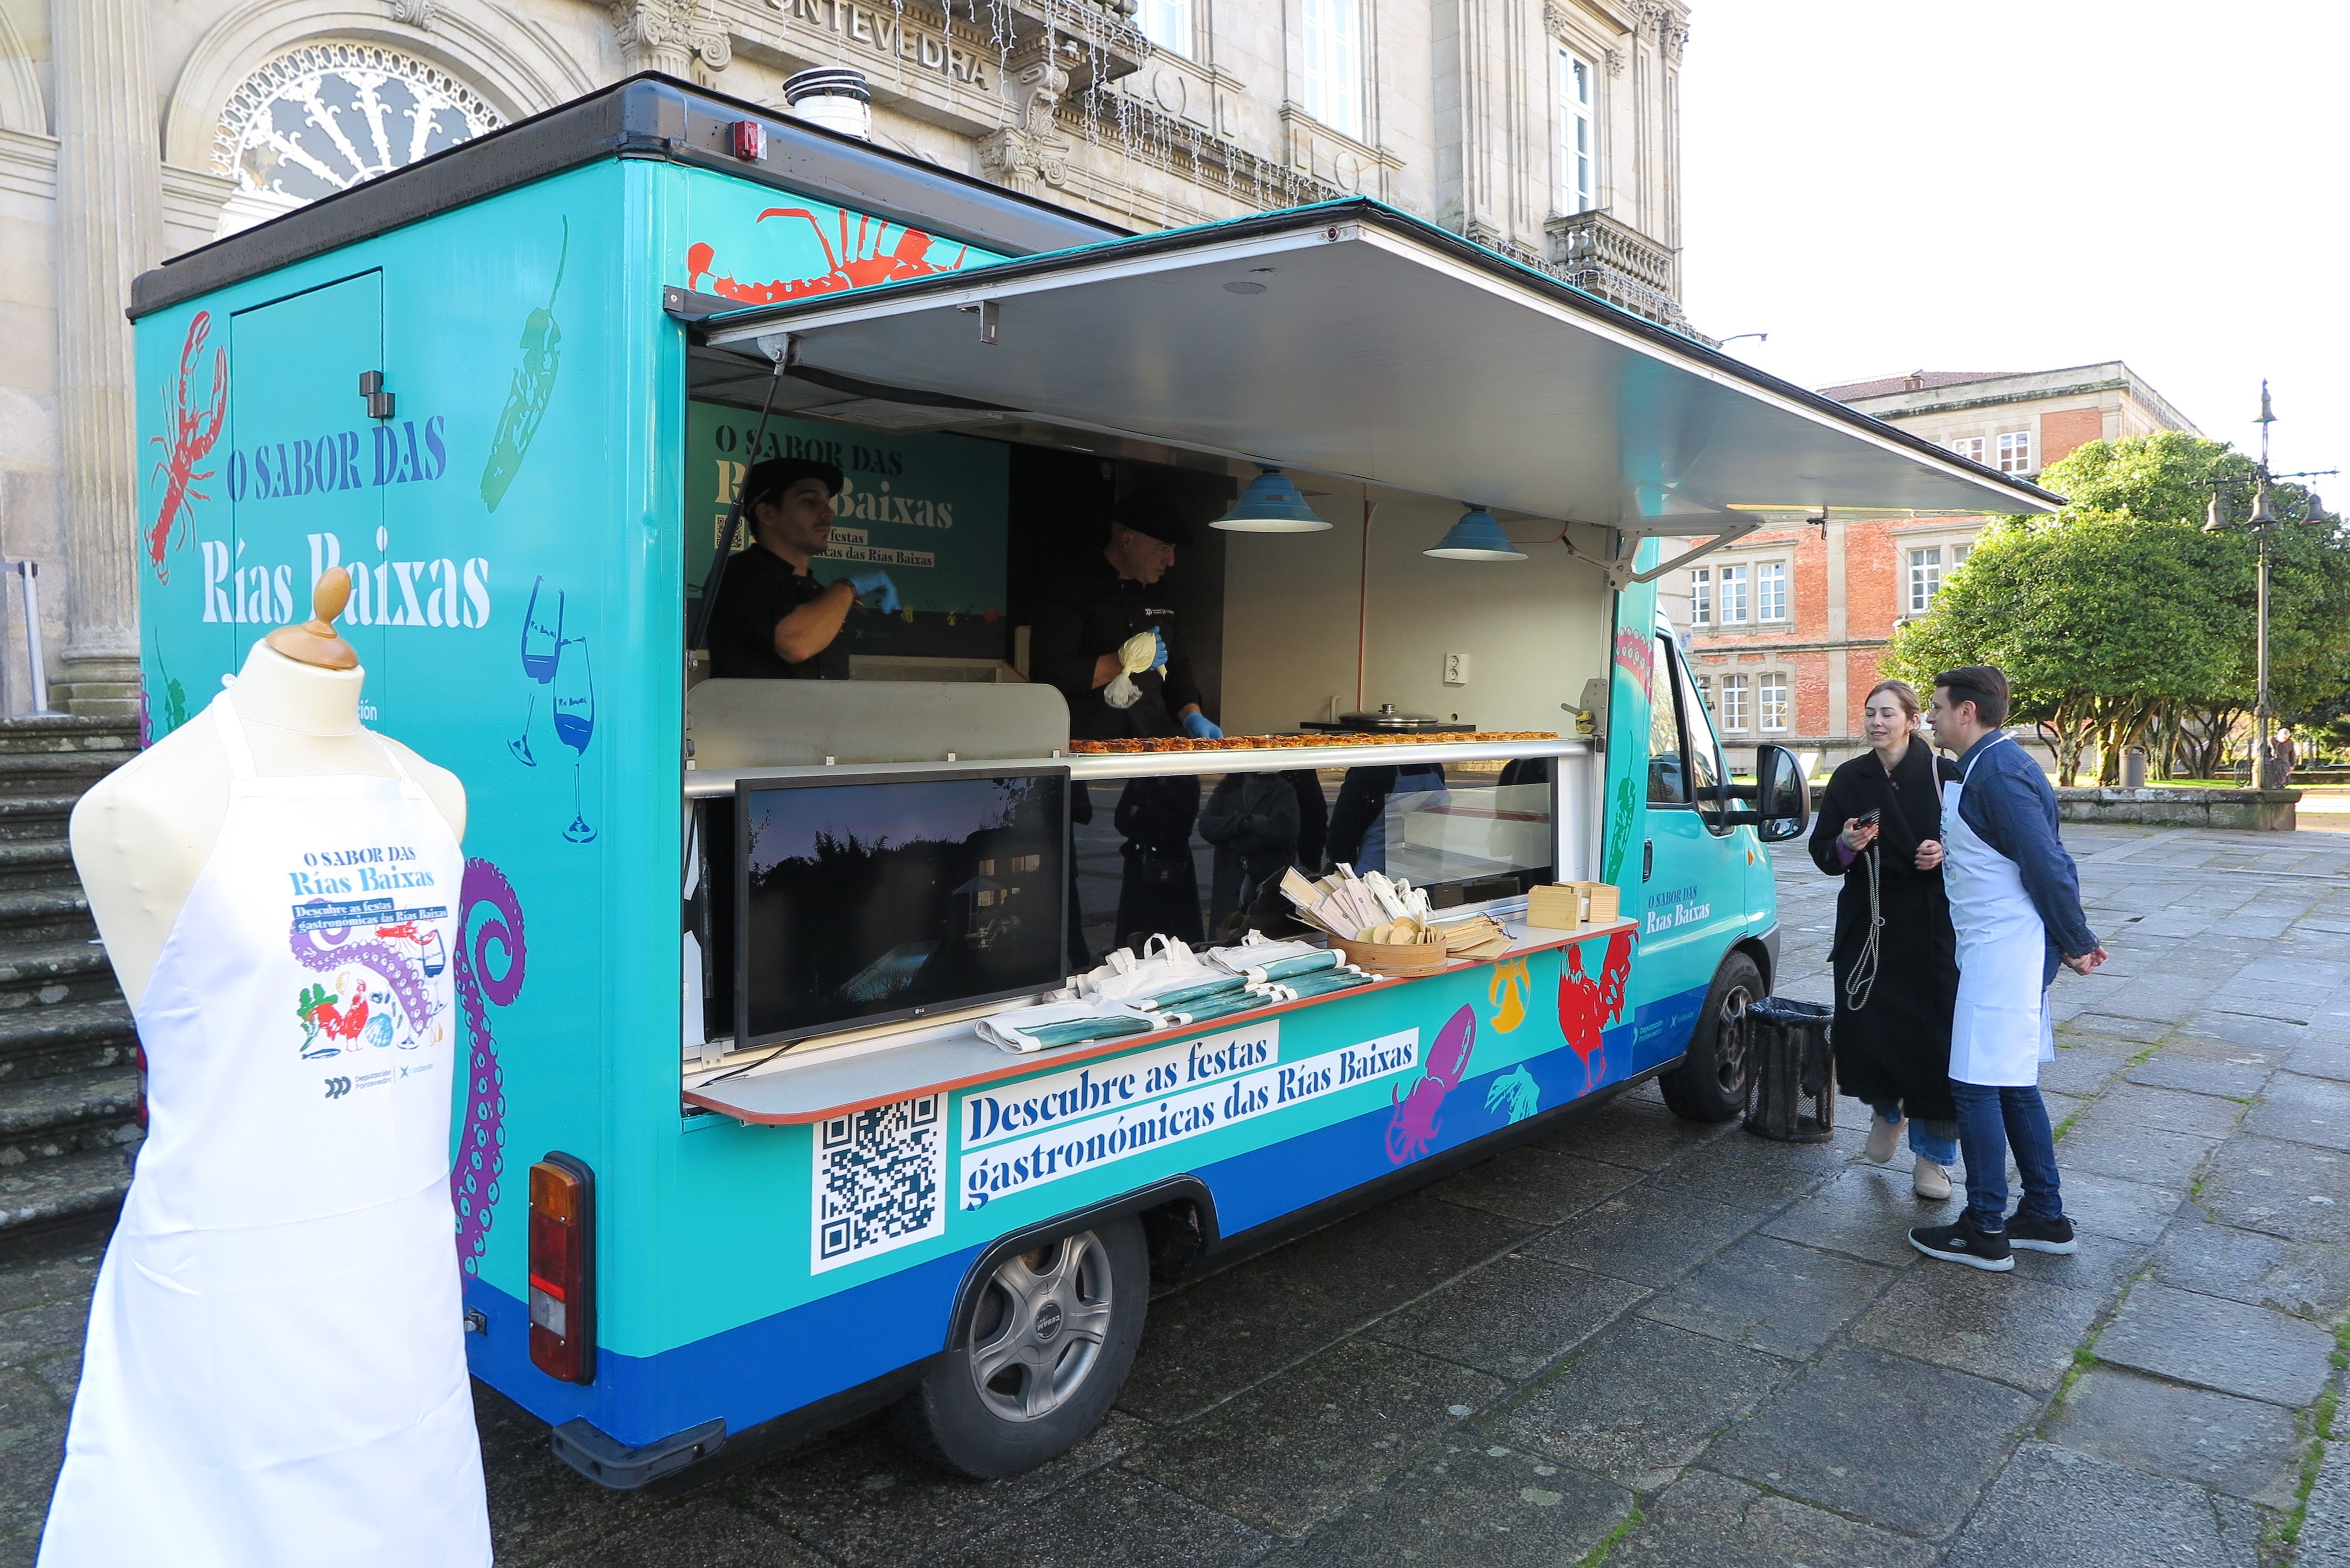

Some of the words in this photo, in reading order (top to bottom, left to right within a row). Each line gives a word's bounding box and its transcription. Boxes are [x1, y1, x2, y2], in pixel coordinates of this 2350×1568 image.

[765, 0, 990, 91] NTEVEDRA
[227, 449, 248, 502] O
[255, 430, 362, 501] SABOR
[372, 415, 447, 486] DAS
[715, 425, 738, 452] O
[746, 428, 843, 469] SABOR
[851, 445, 903, 476] DAS
[830, 528, 864, 544] festas
[846, 546, 865, 560] das
[868, 548, 893, 563] Rías
[896, 552, 932, 566] Baixas
[200, 538, 294, 625] Rías
[307, 525, 491, 629] Baixas
[303, 853, 318, 867] O
[321, 848, 384, 867] SABOR
[387, 846, 416, 862] DAS
[288, 871, 352, 896] Rías
[357, 865, 435, 891] Baixas
[294, 904, 348, 917] Descubre
[349, 905, 362, 913] as
[362, 901, 393, 911] festas
[1648, 895, 1655, 909] O
[1656, 889, 1682, 908] SABOR
[1682, 885, 1697, 901] DAS
[298, 915, 378, 934] gastronómicas
[395, 911, 417, 922] Rías
[418, 908, 448, 919] Baixas
[1674, 900, 1711, 927] Baixas
[968, 1069, 1135, 1142] Descubre
[1145, 1063, 1177, 1093] as
[1186, 1039, 1267, 1083] festas
[966, 1101, 1214, 1211] gastronómicas
[1224, 1080, 1268, 1119] das
[1277, 1064, 1331, 1104] Rías
[1339, 1043, 1412, 1085] Baixas
